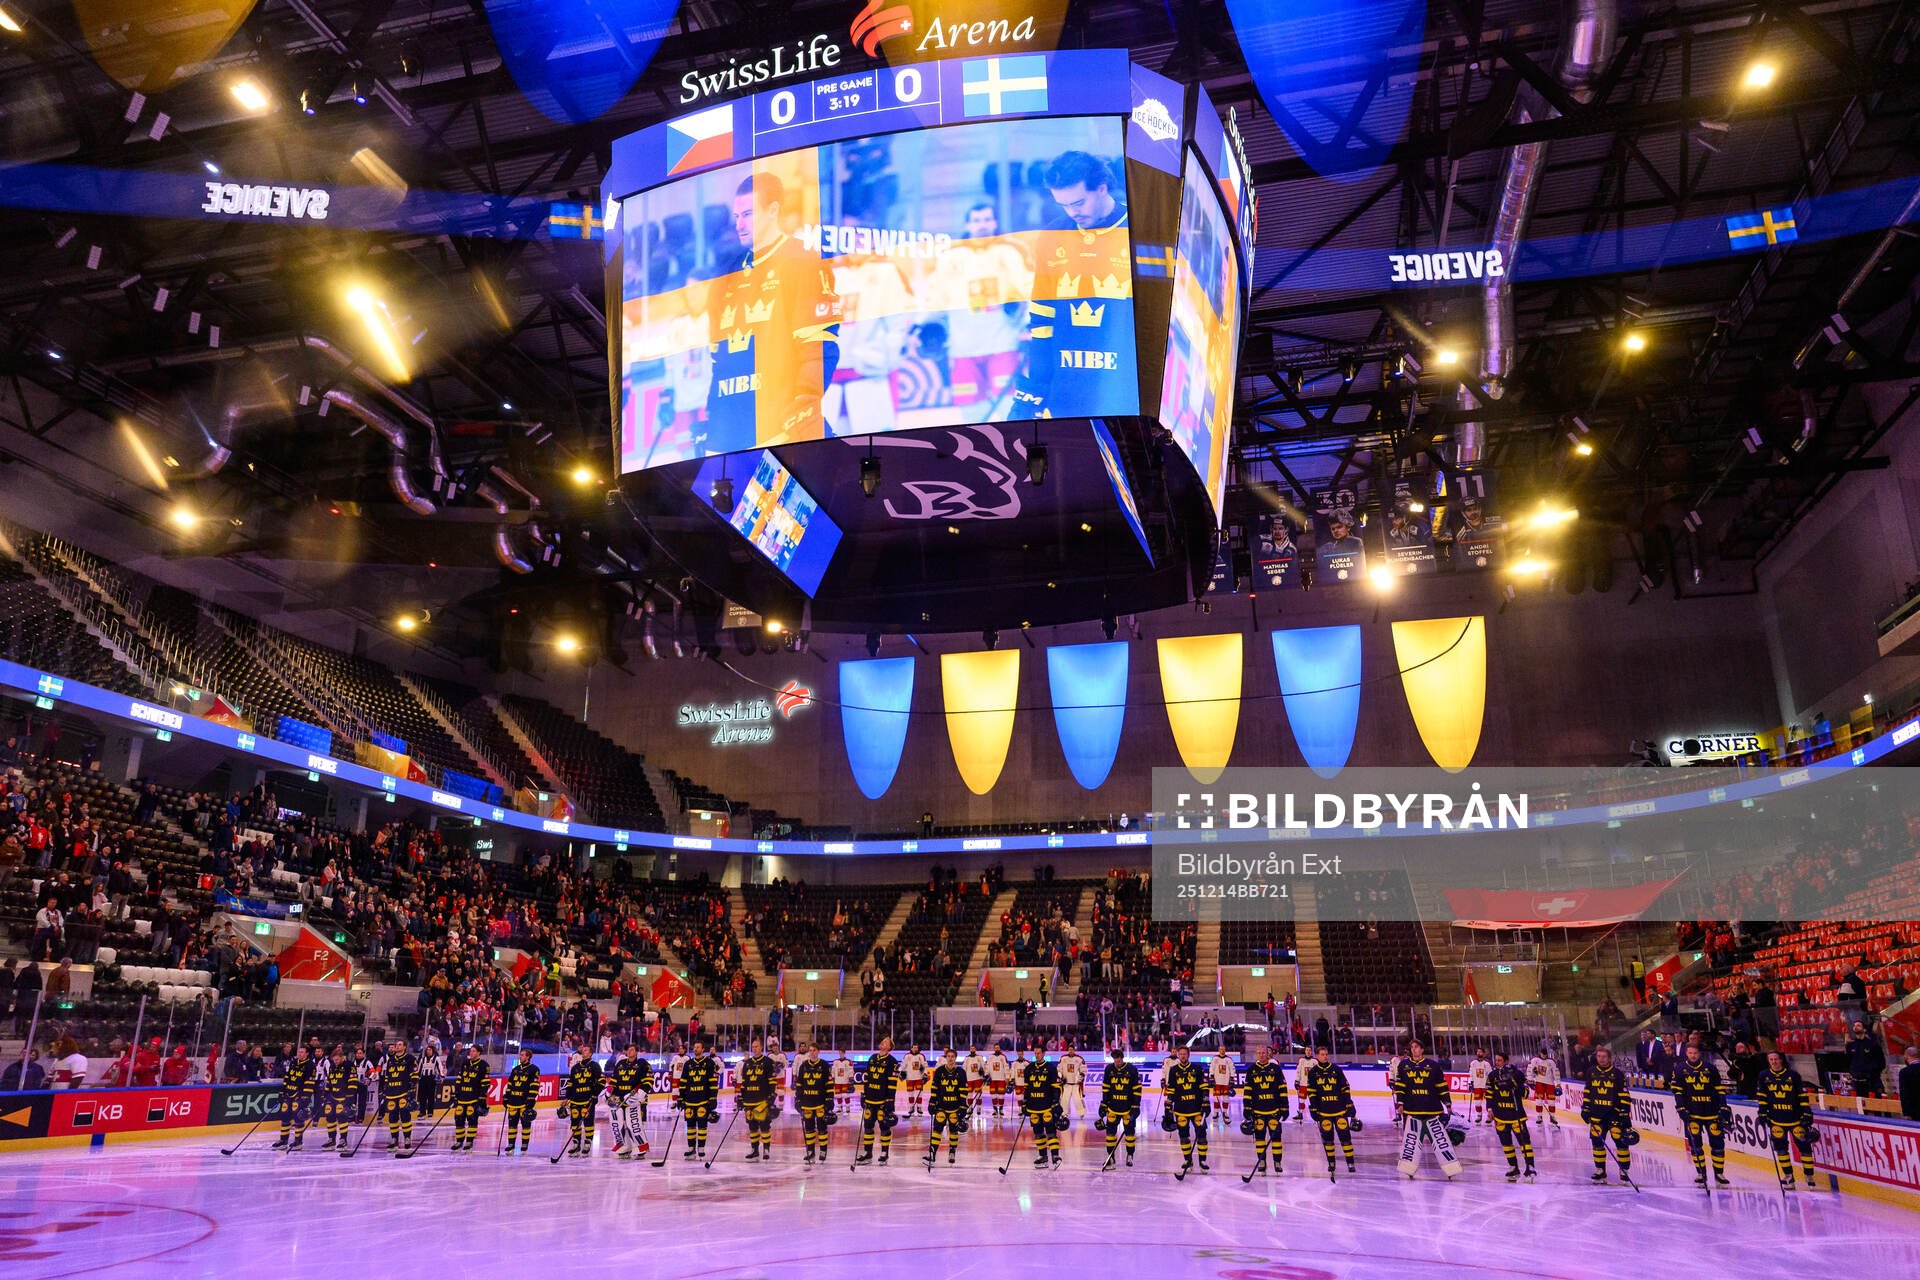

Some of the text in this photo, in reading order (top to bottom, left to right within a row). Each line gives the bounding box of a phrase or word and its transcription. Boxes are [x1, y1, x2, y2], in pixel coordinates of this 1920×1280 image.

[680, 15, 1036, 104] SwissLife Arena
[816, 77, 873, 96] PRE GAME
[895, 68, 922, 103] 0
[770, 90, 796, 125] 0
[828, 94, 860, 111] 3:19
[1133, 111, 1177, 136] ICE HOCKEY
[1059, 350, 1119, 370] NIBE
[718, 373, 762, 398] NIBE
[1456, 474, 1486, 499] 11
[1397, 550, 1423, 558] SEVERIN
[1467, 549, 1494, 557] STOFFEL
[1469, 543, 1490, 552] ANDRI
[679, 699, 772, 725] SwissLife
[711, 723, 774, 745] Arena
[314, 950, 329, 961] F2
[1655, 972, 1664, 981] B
[360, 991, 371, 1000] F2
[168, 1101, 191, 1116] KB
[1691, 1095, 1712, 1103] NIBE
[98, 1104, 123, 1120] KB
[630, 1105, 642, 1134] NOCCO
[1632, 1098, 1665, 1126] TISSOT
[1429, 1117, 1449, 1150] NOCCO
[1402, 1133, 1418, 1162] NOCCO
